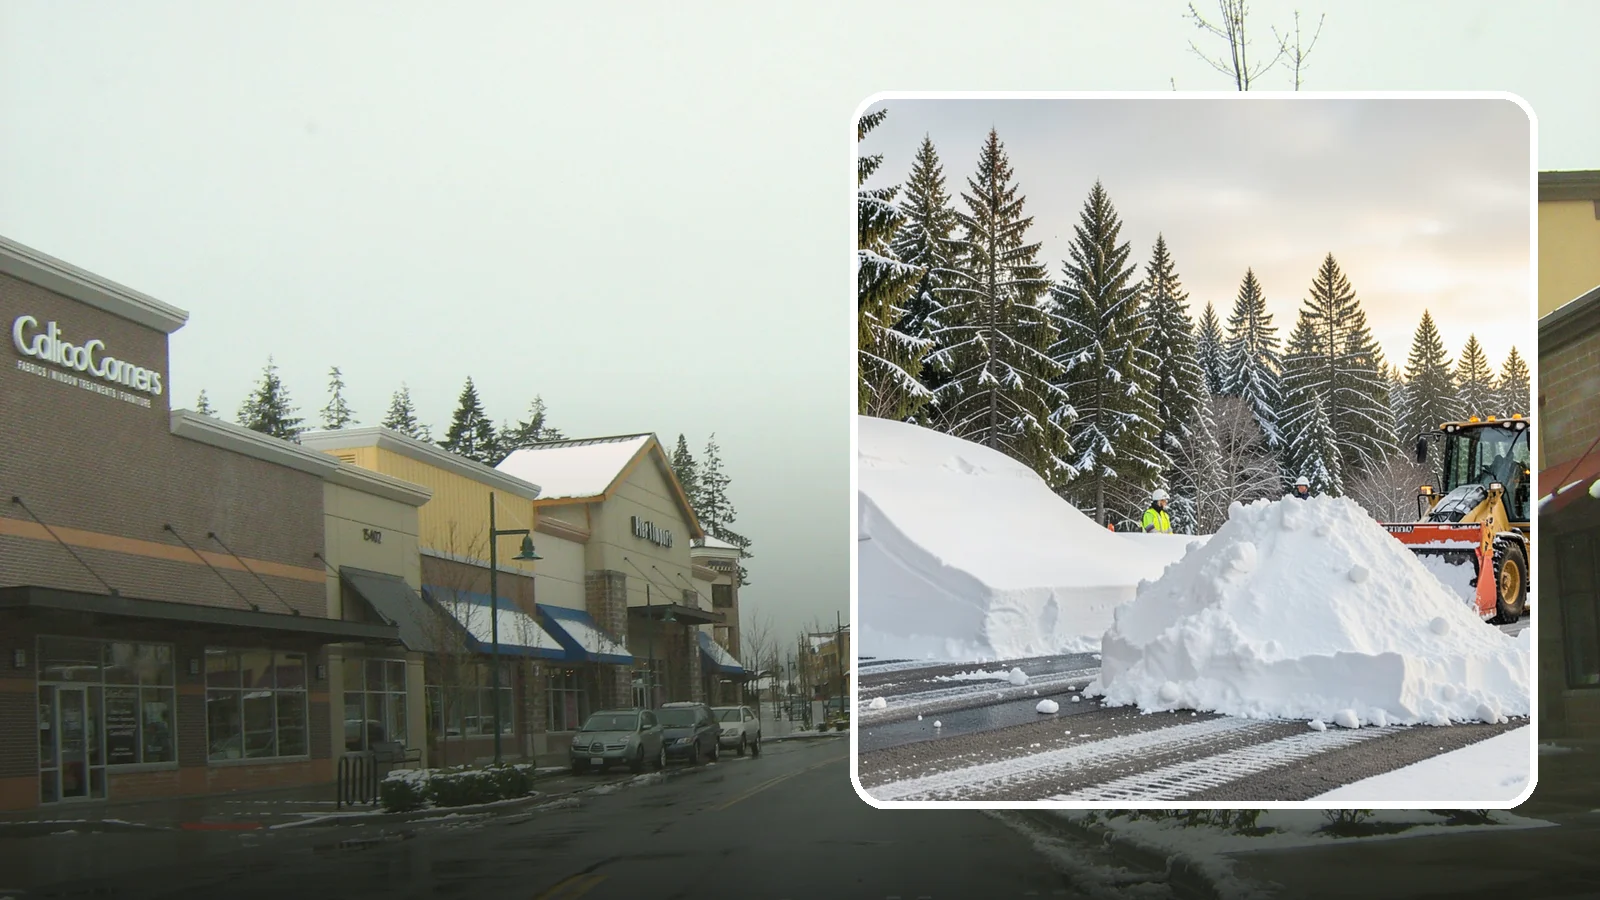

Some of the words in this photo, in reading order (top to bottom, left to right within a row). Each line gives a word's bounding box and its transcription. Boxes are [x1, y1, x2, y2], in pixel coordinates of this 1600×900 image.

[17, 360, 47, 378] FABRICS
[51, 370, 78, 387] WINDOW
[79, 378, 117, 399] TREATMENTS
[120, 390, 152, 409] FURNITURE
